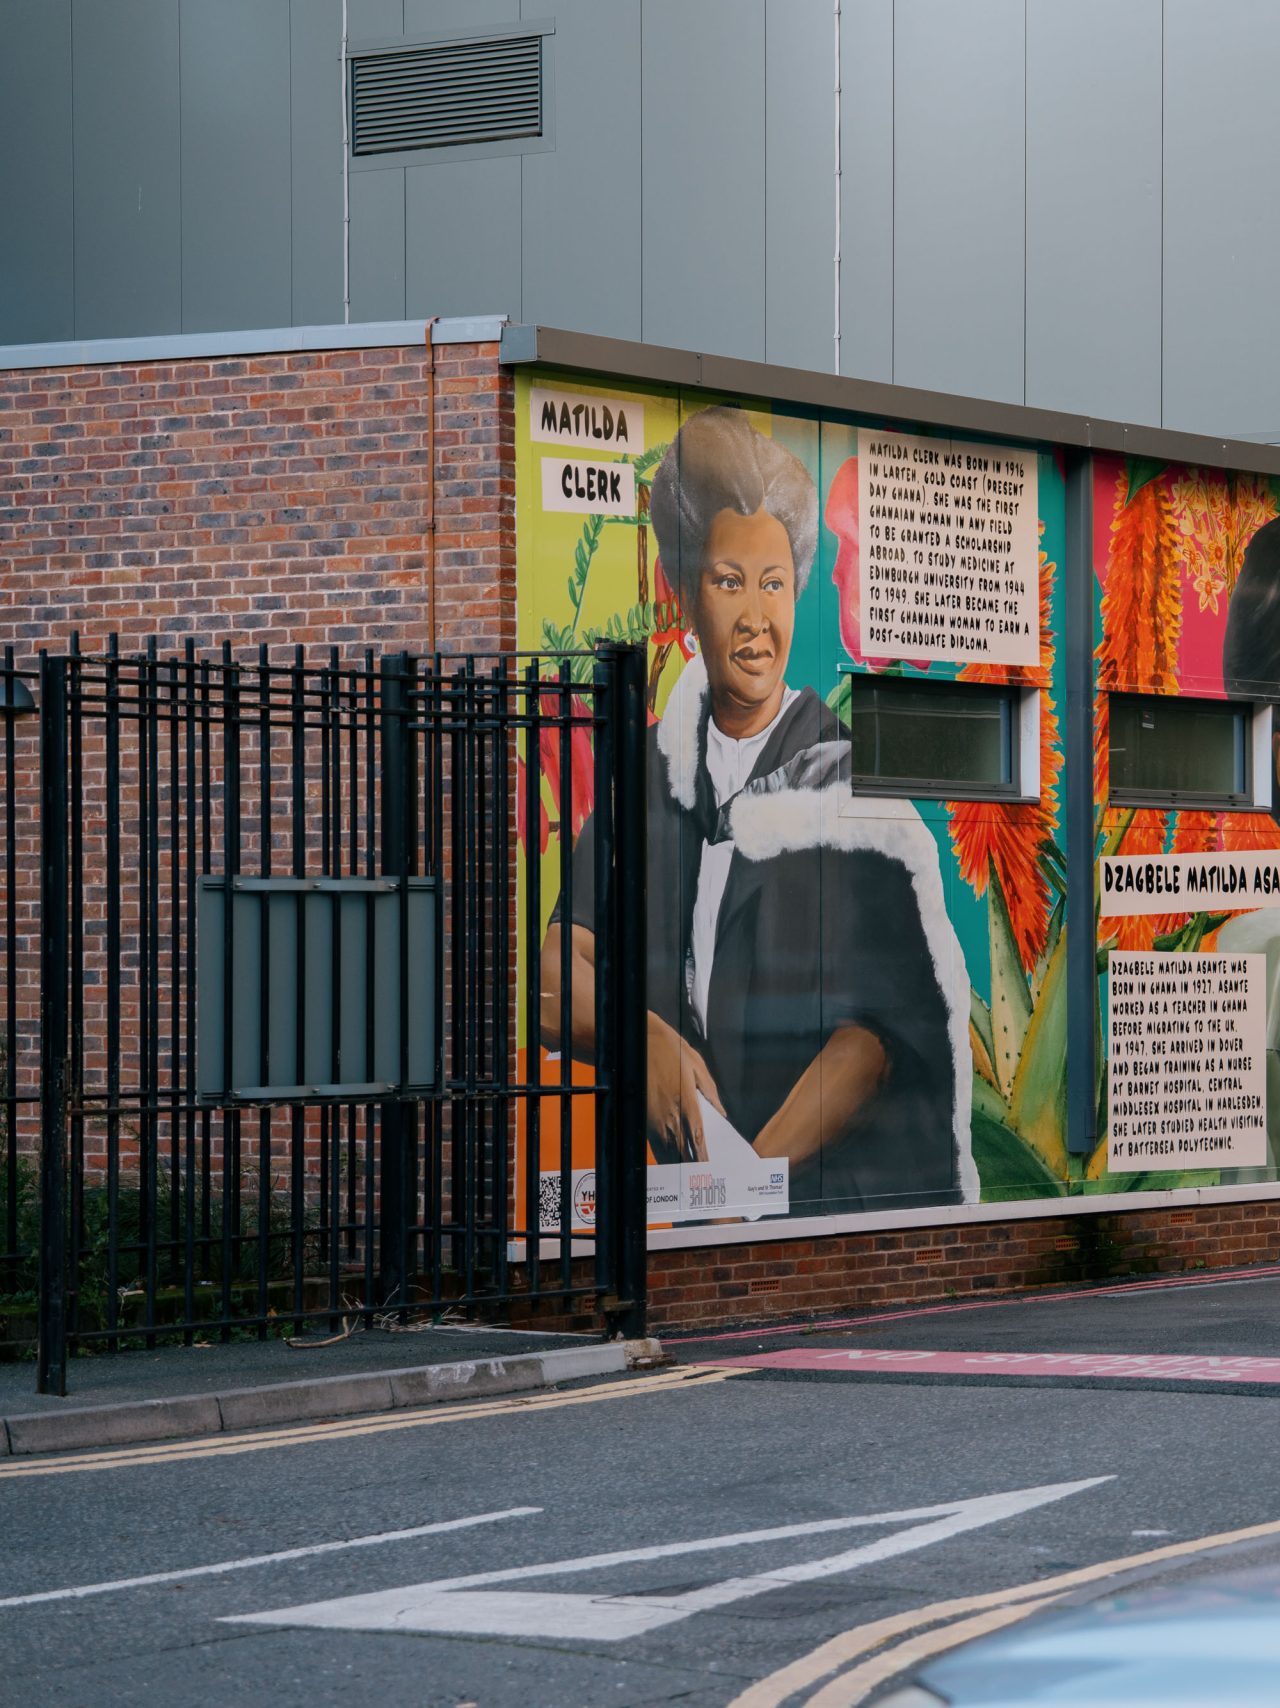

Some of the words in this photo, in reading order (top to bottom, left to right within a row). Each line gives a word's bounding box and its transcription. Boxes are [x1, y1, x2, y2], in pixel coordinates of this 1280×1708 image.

[541, 401, 628, 441] MATILDA
[869, 442, 908, 460] MATILDA
[912, 447, 939, 464] CLERK
[943, 451, 962, 468] WAS
[966, 455, 989, 472] BORN
[993, 459, 1001, 474] IN
[1005, 461, 1024, 478] 1916
[561, 464, 622, 502] CLERK
[869, 463, 878, 476] IN
[924, 471, 945, 486] GOLD
[949, 473, 977, 490] COAST
[982, 477, 1023, 496] (PRESENT
[869, 482, 887, 499] DAY
[933, 491, 949, 507] SHE
[953, 495, 971, 510] WAS
[976, 497, 991, 512] THE
[995, 500, 1019, 515] FIRST
[869, 505, 914, 522] GHANAIAN
[919, 512, 951, 526] WOMAN
[955, 515, 964, 528] IN
[968, 516, 985, 532] ANY
[989, 519, 1012, 534] FIELD
[869, 524, 879, 538] TO
[884, 525, 895, 541] BE
[900, 529, 940, 546] GRANTED
[945, 534, 950, 546] A
[955, 534, 1011, 553] SCHOLARSHIP
[913, 550, 923, 564] TO
[928, 551, 955, 568] STUDY
[960, 556, 999, 573] MEDICINE
[1004, 561, 1014, 573] AT
[869, 565, 919, 583] EDINBURGH
[923, 572, 974, 590] UNIVERSITY
[978, 577, 1000, 592] FROM
[1004, 580, 1024, 594] 1944
[869, 586, 880, 600] TO
[914, 590, 929, 606] SHE
[934, 593, 960, 608] LATER
[965, 595, 998, 613] BECAME
[1003, 600, 1017, 615] THE
[869, 606, 895, 622] FIRST
[900, 610, 944, 626] GHANAIAN
[949, 616, 980, 630] WOMAN
[985, 618, 994, 632] TO
[999, 619, 1020, 633] EARN
[1024, 622, 1029, 634] A
[869, 627, 945, 648] POST-GRADUATE
[1104, 862, 1180, 894] DZAGBELE
[1187, 864, 1247, 893] MATILDA
[1112, 960, 1154, 975] DZAGBELE
[1158, 960, 1192, 974] MATILDA
[1196, 960, 1226, 974] ASANTE
[1230, 960, 1246, 973] WAS
[1112, 981, 1133, 995] BORN
[1137, 982, 1146, 994] IN
[1150, 981, 1176, 994] GHANA
[1180, 981, 1188, 993] IN
[1218, 979, 1248, 993] ASANTE
[1112, 1000, 1144, 1015] WORKED
[1148, 1000, 1158, 1015] AS
[1162, 1001, 1167, 1013] A
[1172, 1000, 1206, 1014] TEACHER
[1210, 1000, 1217, 1012] IN
[1221, 999, 1247, 1012] GHANA
[1112, 1021, 1142, 1036] BEFORE
[1146, 1020, 1190, 1034] MIGRATING
[1194, 1019, 1203, 1032] TO
[1207, 1019, 1221, 1032] THE
[1112, 1042, 1120, 1055] IN
[1151, 1040, 1166, 1055] SHE
[1170, 1039, 1203, 1053] ARRIVED
[1207, 1039, 1215, 1051] IN
[1219, 1037, 1243, 1051] DOVER
[1112, 1061, 1128, 1075] AND
[1133, 1061, 1159, 1075] BEGAN
[1163, 1060, 1200, 1073] TRAINING
[1204, 1058, 1214, 1072] AS
[1218, 1058, 1223, 1070] A
[1227, 1056, 1251, 1070] NURSE
[1112, 1082, 1123, 1096] AT
[1127, 1080, 1159, 1096] BARNET
[1208, 1077, 1242, 1091] CENTRAL
[1112, 1101, 1159, 1116] MIDDLESEX
[1163, 1098, 1201, 1113] HOSPITAL
[1205, 1098, 1213, 1110] IN
[1113, 1122, 1127, 1137] SHE
[1131, 1121, 1156, 1135] LATER
[1160, 1118, 1194, 1134] STUDIED
[1198, 1117, 1227, 1131] HEALTH
[1230, 1115, 1263, 1129] VISITING
[1113, 1142, 1123, 1156] AT
[1128, 1140, 1174, 1156] BATTERSEA
[771, 1174, 784, 1183] NHS
[653, 1195, 678, 1203] LONDON
[816, 1351, 937, 1360] NO
[1078, 1365, 1255, 1380] THIS
